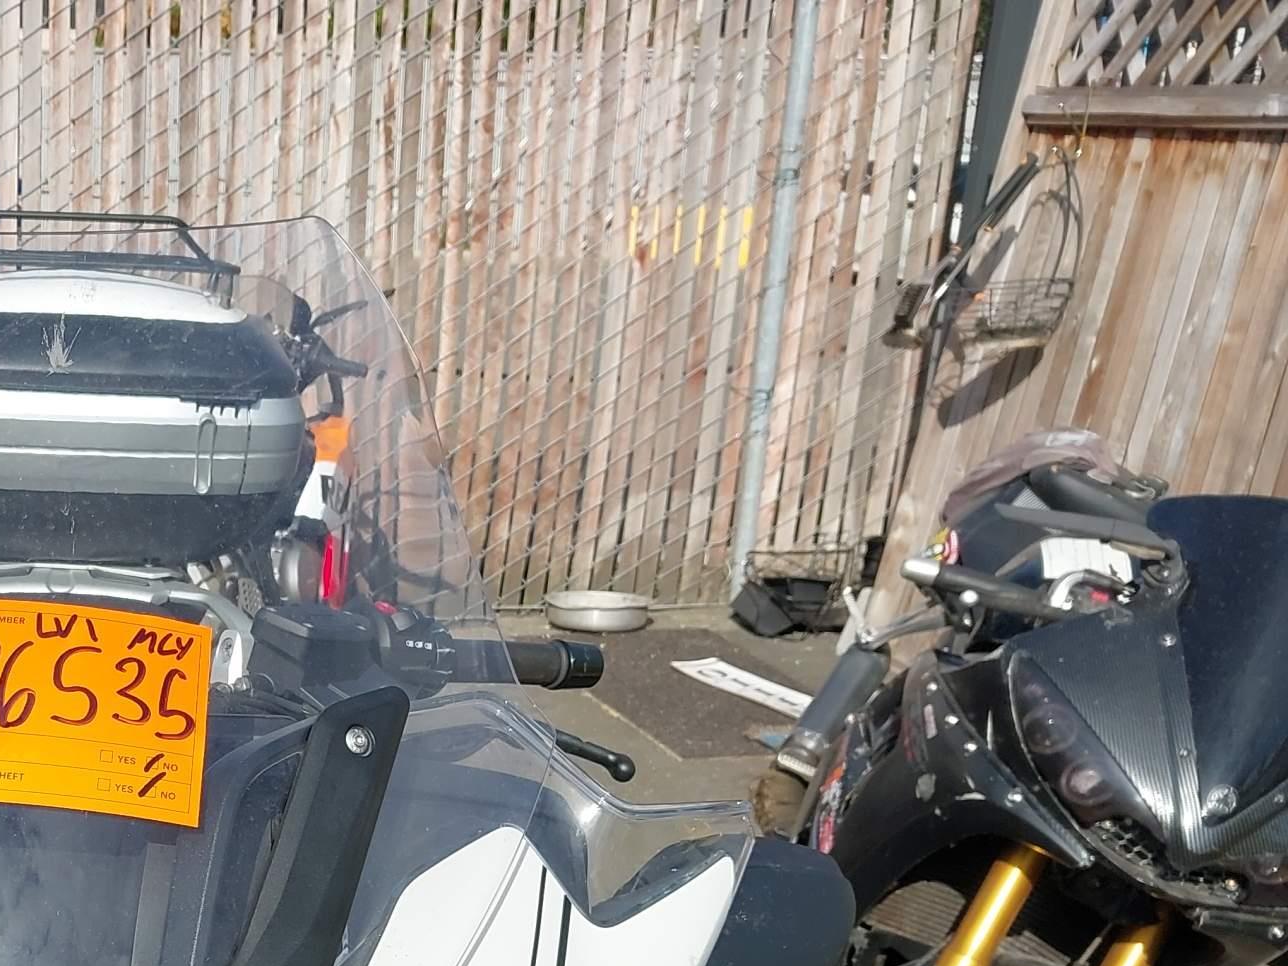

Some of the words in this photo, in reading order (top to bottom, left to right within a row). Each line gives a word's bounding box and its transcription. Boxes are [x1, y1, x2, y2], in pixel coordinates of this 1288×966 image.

[117, 755, 136, 765] YES
[162, 762, 179, 772] NO
[115, 783, 134, 794] YES
[160, 790, 176, 801] NO
